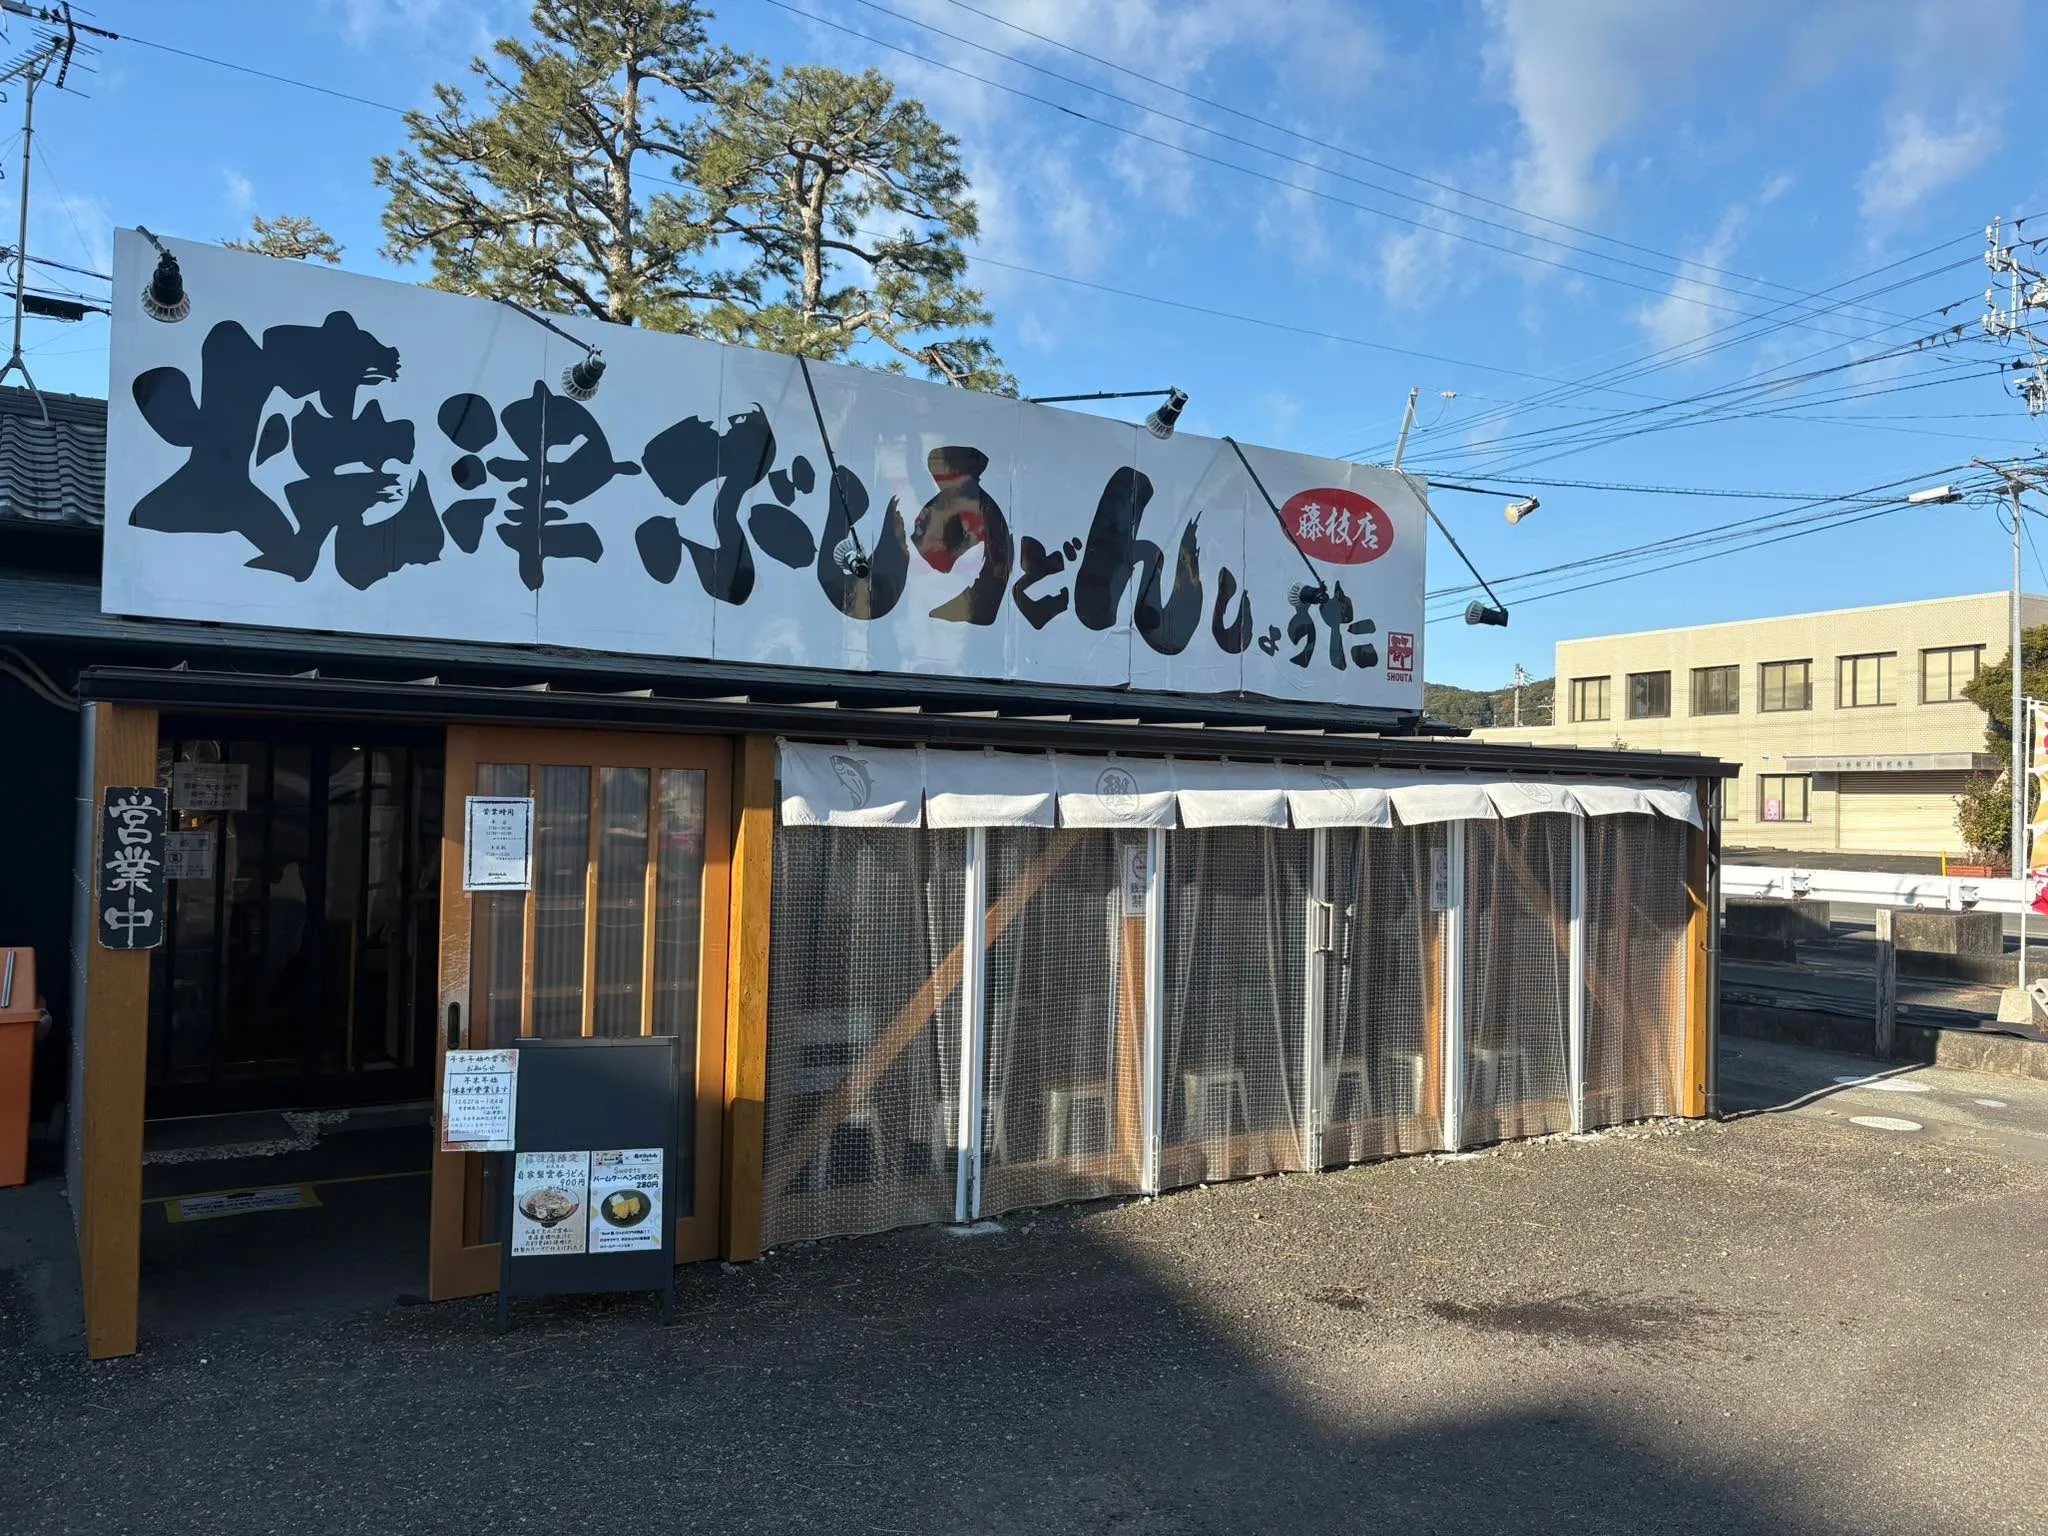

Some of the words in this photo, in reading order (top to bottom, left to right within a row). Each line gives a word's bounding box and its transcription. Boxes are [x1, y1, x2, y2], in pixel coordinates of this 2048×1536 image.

[1295, 502, 1379, 550] 藤枝店
[1386, 672, 1413, 684] SHOUTA
[104, 795, 162, 948] 営業中
[560, 1178, 586, 1187] 900円
